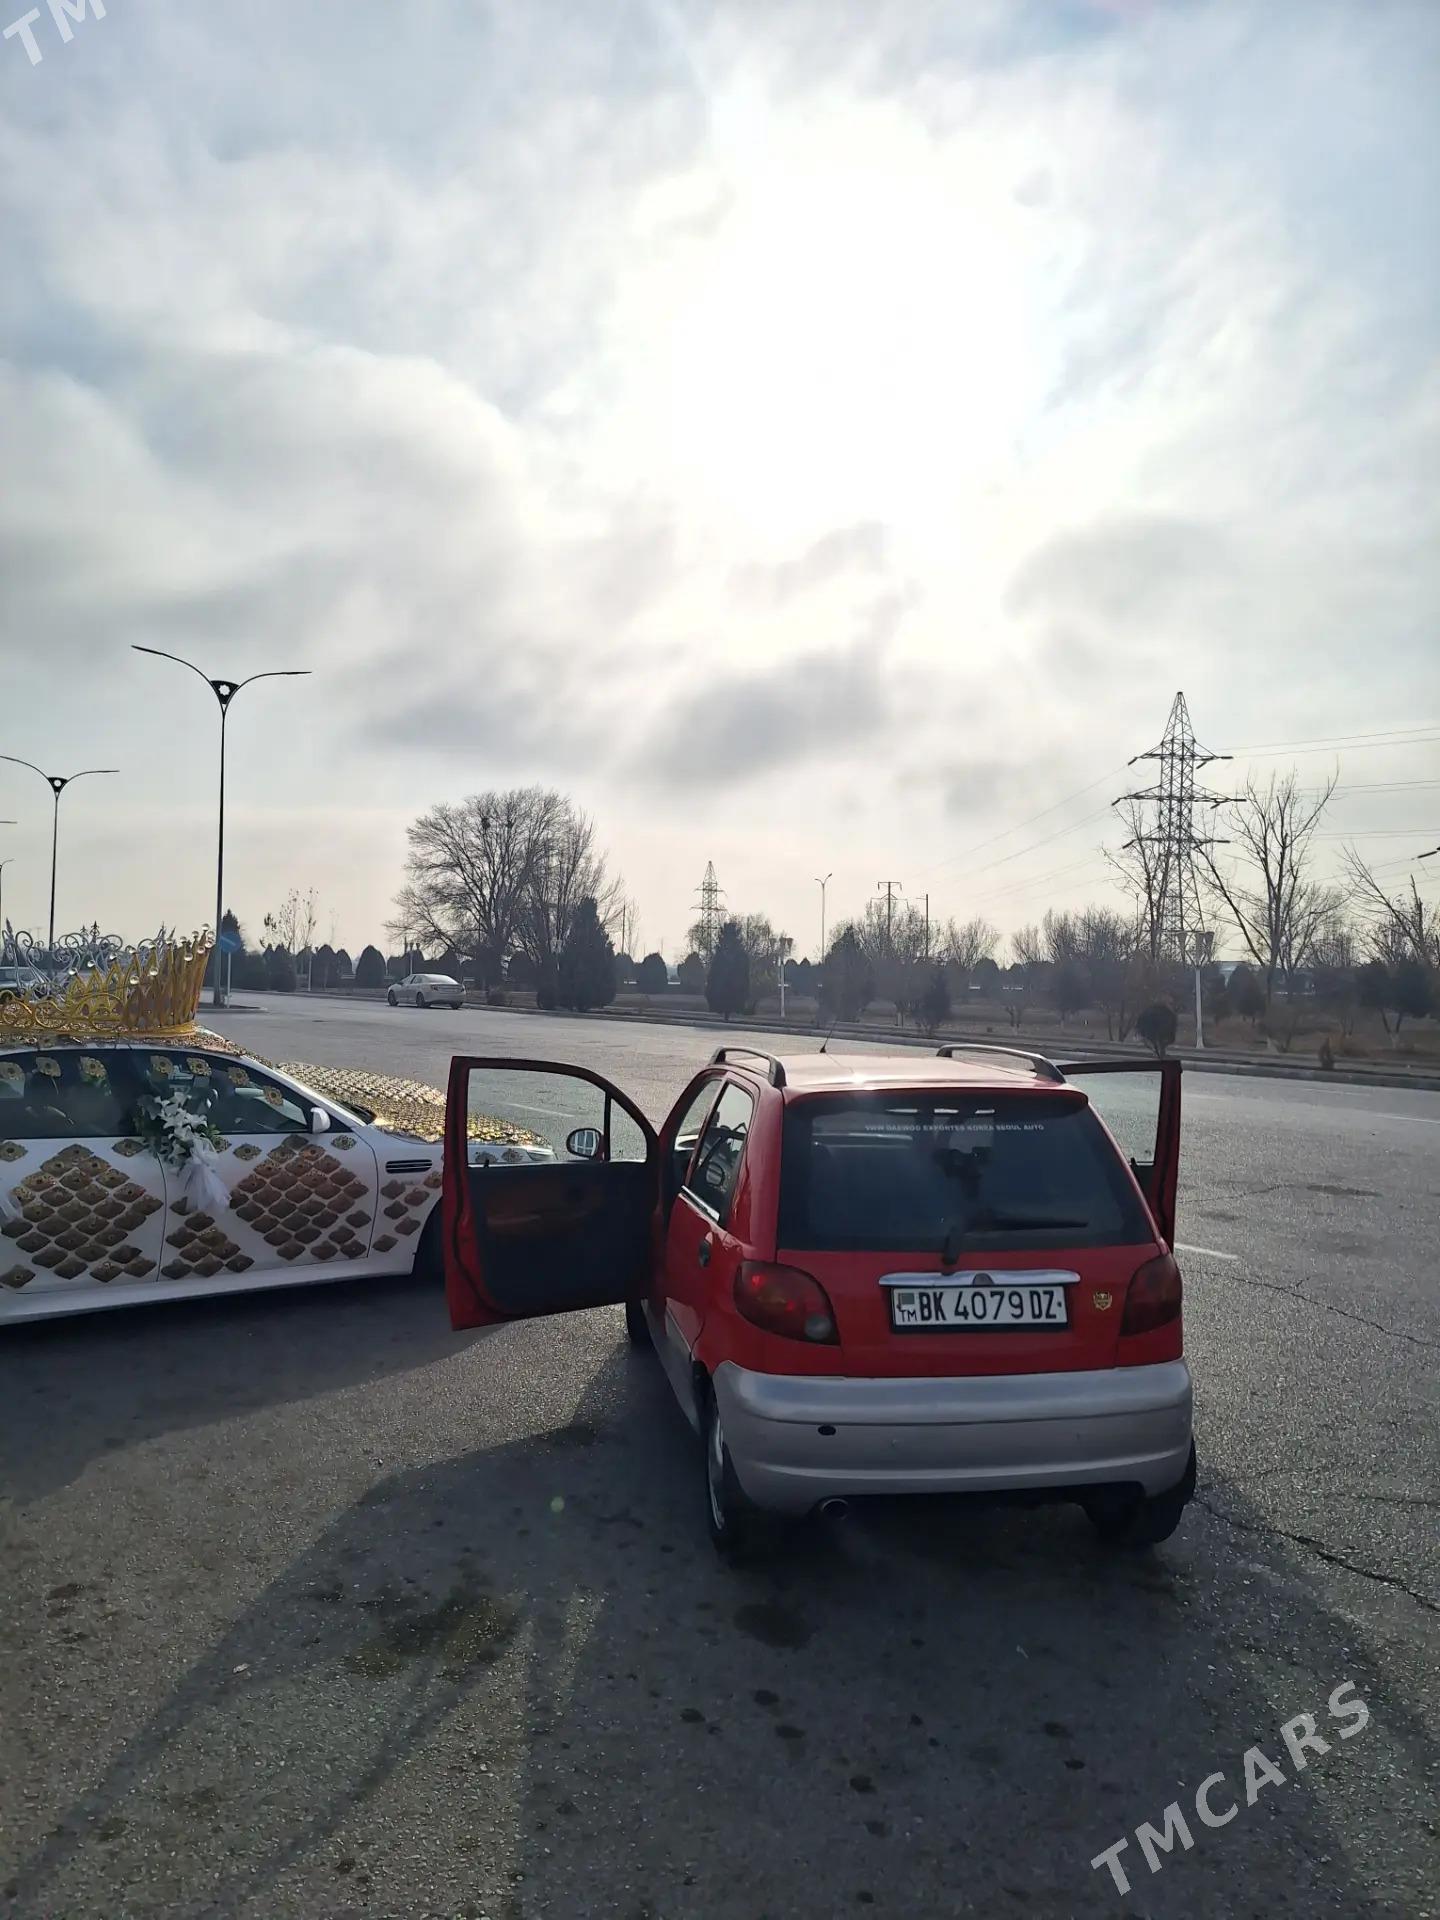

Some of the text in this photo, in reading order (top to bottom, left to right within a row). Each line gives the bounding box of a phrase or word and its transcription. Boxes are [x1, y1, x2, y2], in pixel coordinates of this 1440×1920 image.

[995, 1124, 1022, 1132] SEOUL
[918, 1289, 1058, 1322] BK 4079 DZ
[900, 1309, 918, 1323] TM
